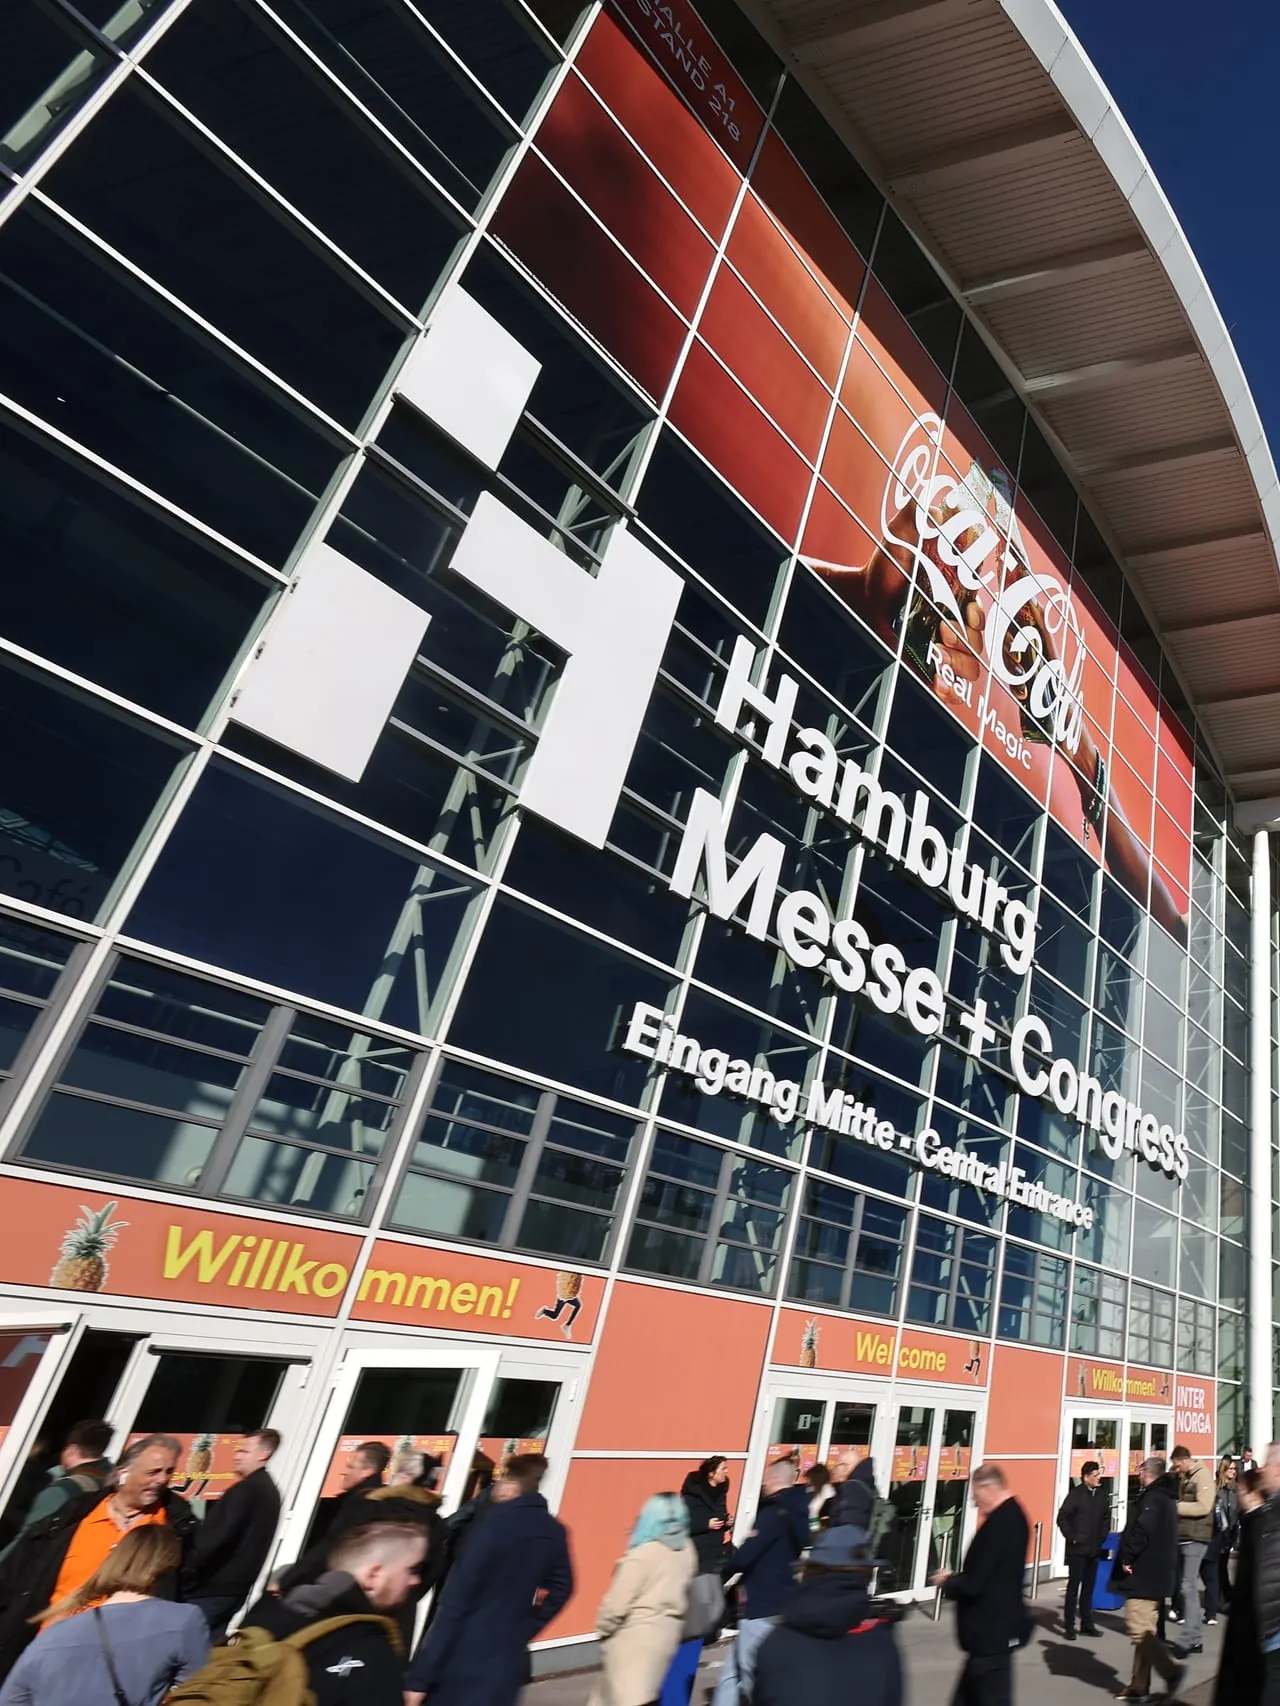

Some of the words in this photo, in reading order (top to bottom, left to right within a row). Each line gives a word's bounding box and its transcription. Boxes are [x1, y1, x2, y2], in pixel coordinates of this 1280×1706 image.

[655, 0, 712, 79] ALLE
[713, 83, 736, 112] A1
[708, 95, 740, 142] 218
[881, 412, 1086, 755] Coca-Cola
[926, 640, 973, 709] Real
[976, 694, 1033, 770] Magic
[714, 634, 1037, 976] Hamburg
[668, 787, 946, 1036] Messe
[960, 998, 996, 1058] +
[1010, 1014, 1190, 1180] Congress
[622, 1001, 800, 1124] Eingang
[805, 1078, 895, 1151] Mitte
[914, 1128, 1007, 1196] Central
[1009, 1166, 1094, 1231] Entrance
[162, 1224, 521, 1320] Willkommen!
[856, 1331, 948, 1373] Welcome
[1092, 1367, 1156, 1397] Willkommen!
[1176, 1385, 1206, 1410] INTER
[1175, 1411, 1213, 1435] NORGA
